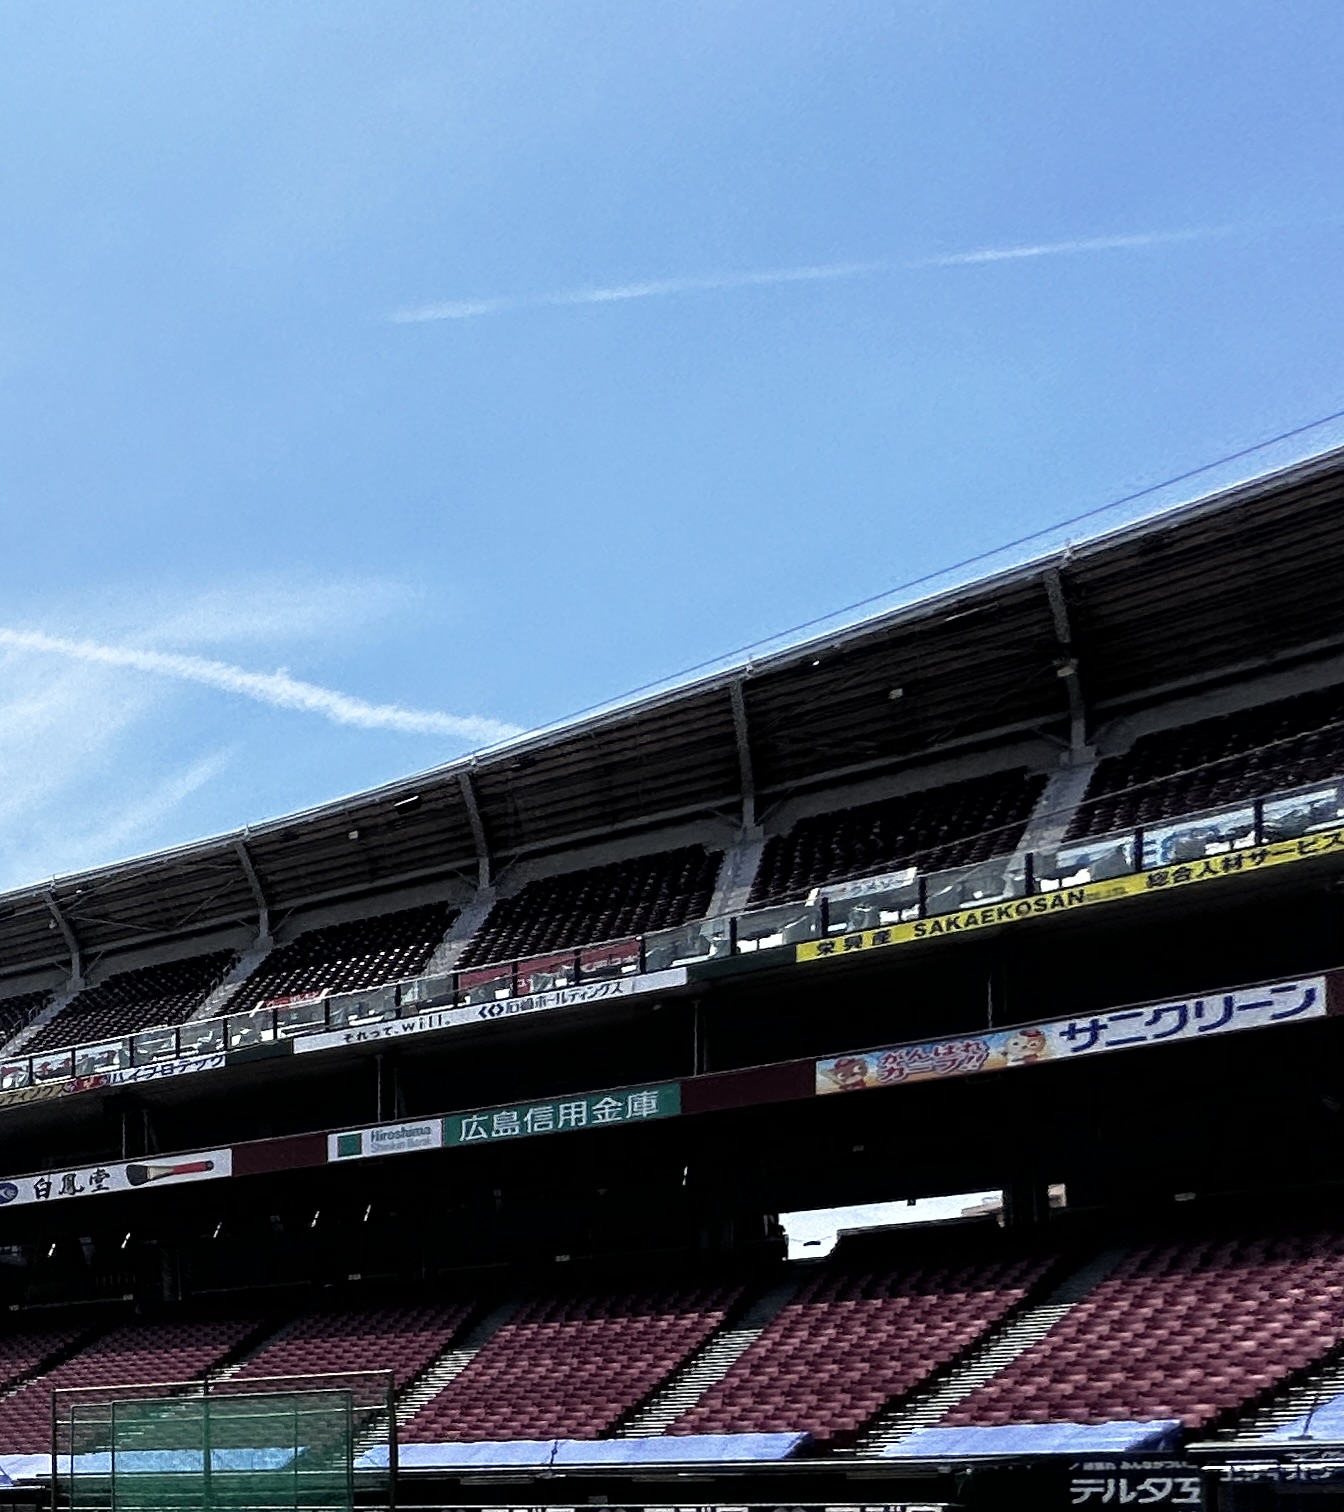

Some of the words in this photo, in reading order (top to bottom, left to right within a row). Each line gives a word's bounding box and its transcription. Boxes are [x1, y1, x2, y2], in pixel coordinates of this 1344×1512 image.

[914, 888, 1085, 938] SAKAEKOSAN
[1059, 985, 1316, 1052] サニクリーン
[370, 1125, 432, 1142] Hiroshima
[458, 1091, 661, 1143] 広島信用金庫
